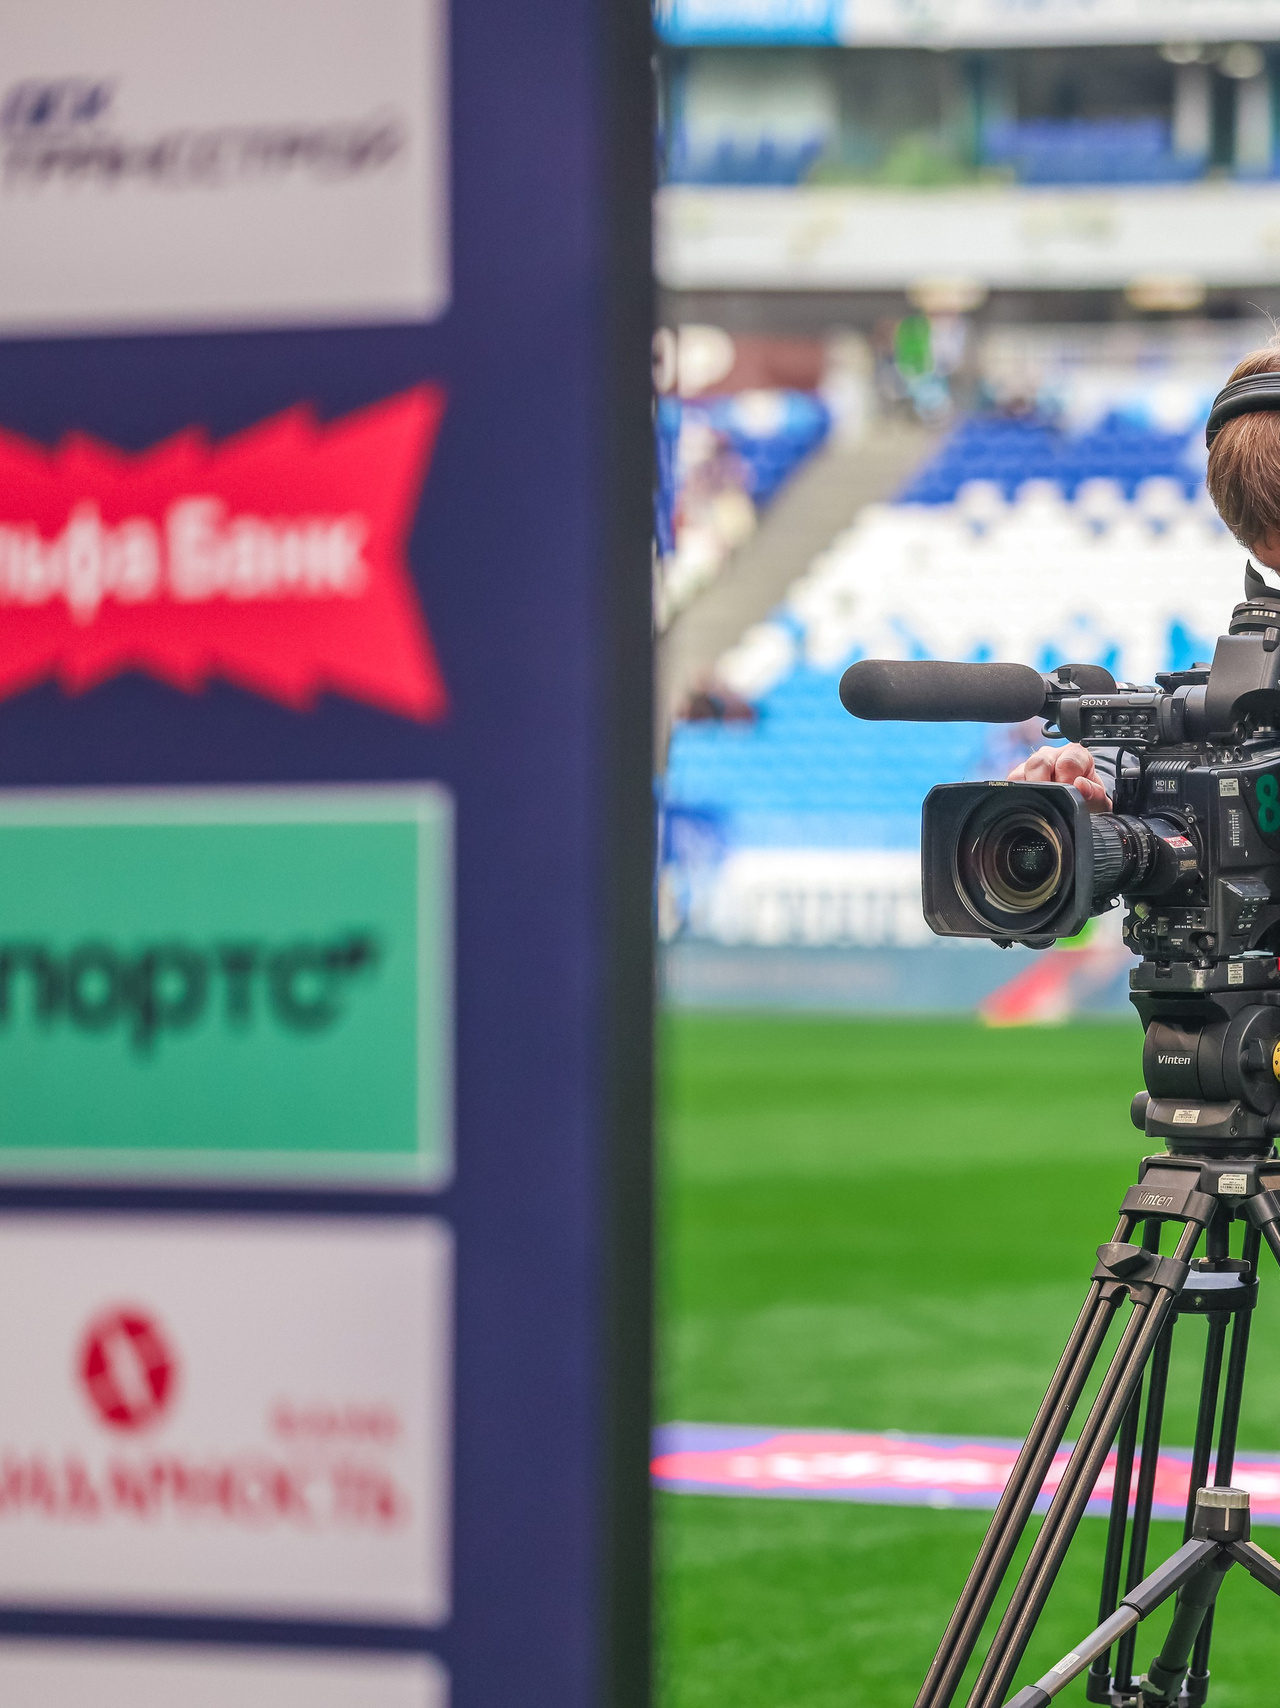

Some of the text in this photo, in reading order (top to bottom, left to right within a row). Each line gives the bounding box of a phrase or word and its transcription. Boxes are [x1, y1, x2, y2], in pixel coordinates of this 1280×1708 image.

[167, 496, 367, 600] Банк
[1157, 1054, 1191, 1065] Vinten
[1136, 1191, 1174, 1207] Vinten
